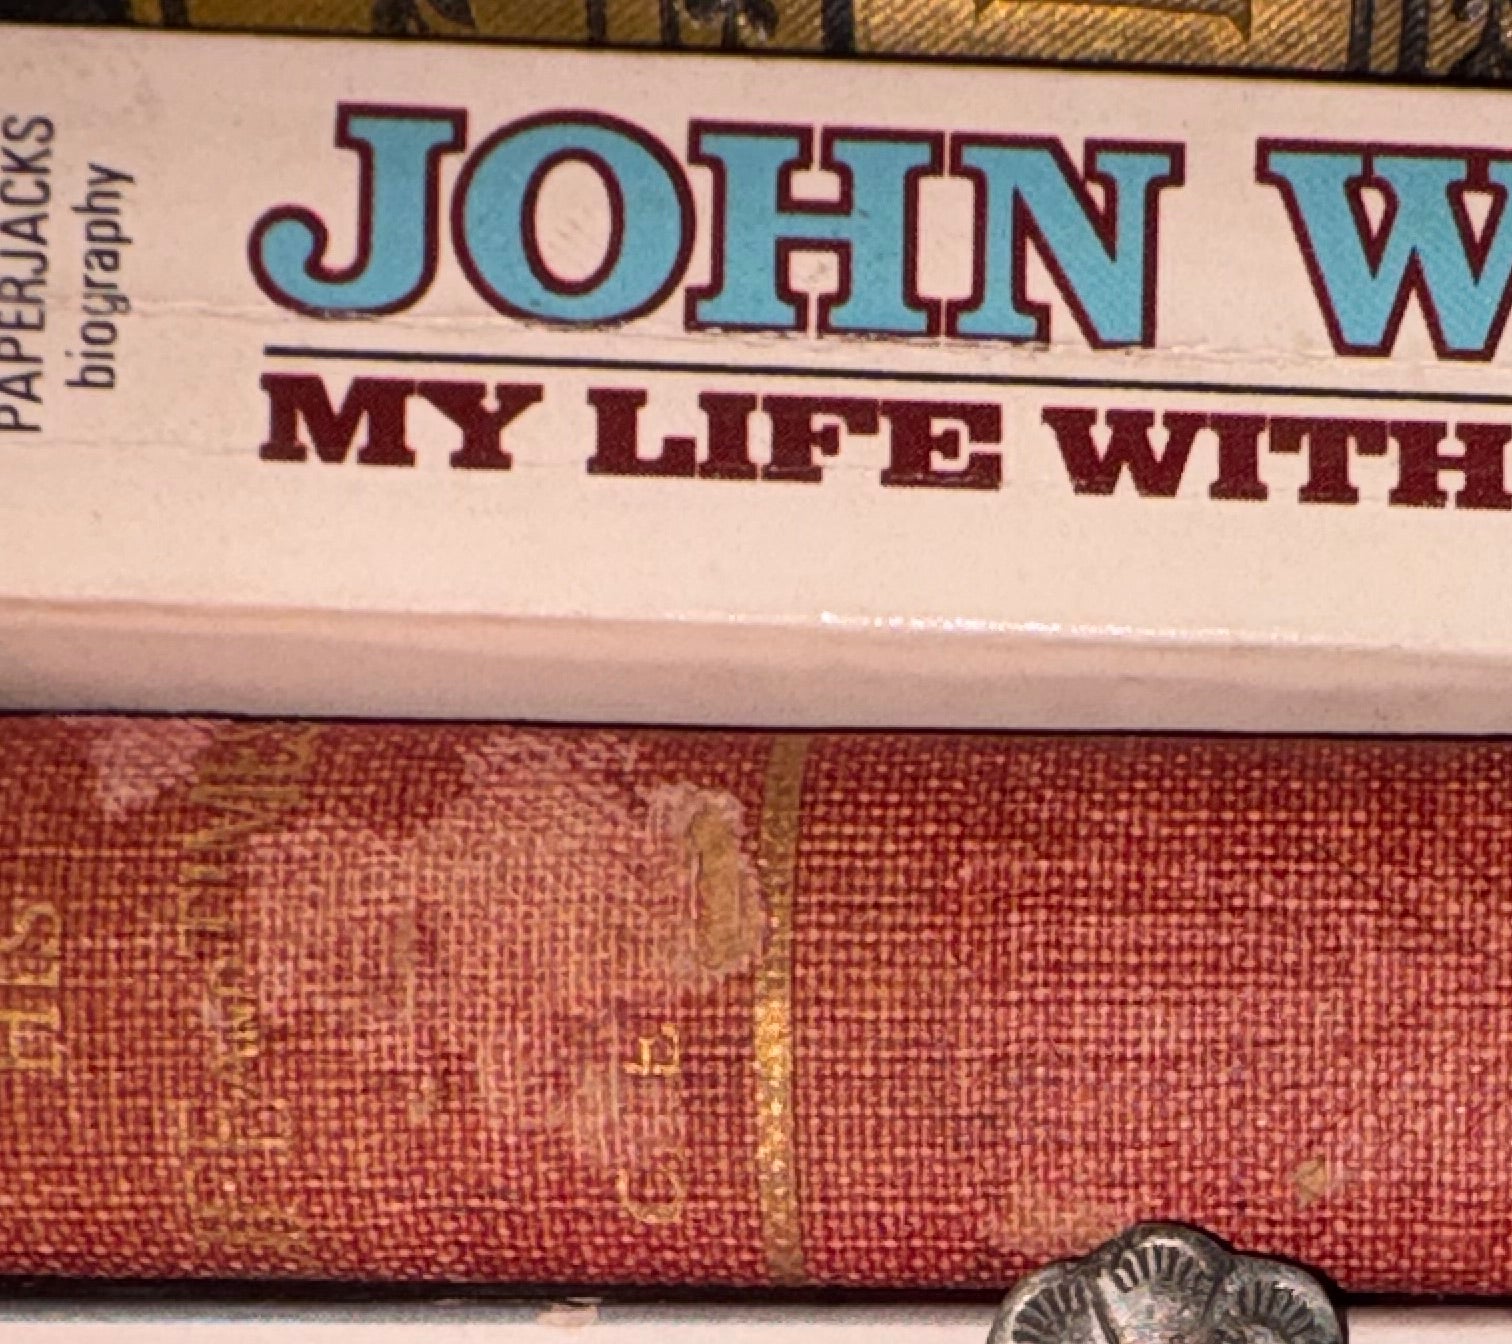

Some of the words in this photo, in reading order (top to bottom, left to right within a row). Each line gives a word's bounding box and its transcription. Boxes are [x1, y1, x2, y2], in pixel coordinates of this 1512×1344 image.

[0, 114, 55, 433] PAPERJACKS
[64, 162, 136, 389] biography
[247, 101, 1187, 350] JOHN
[259, 373, 544, 470] MY
[586, 387, 1001, 490] LIFE
